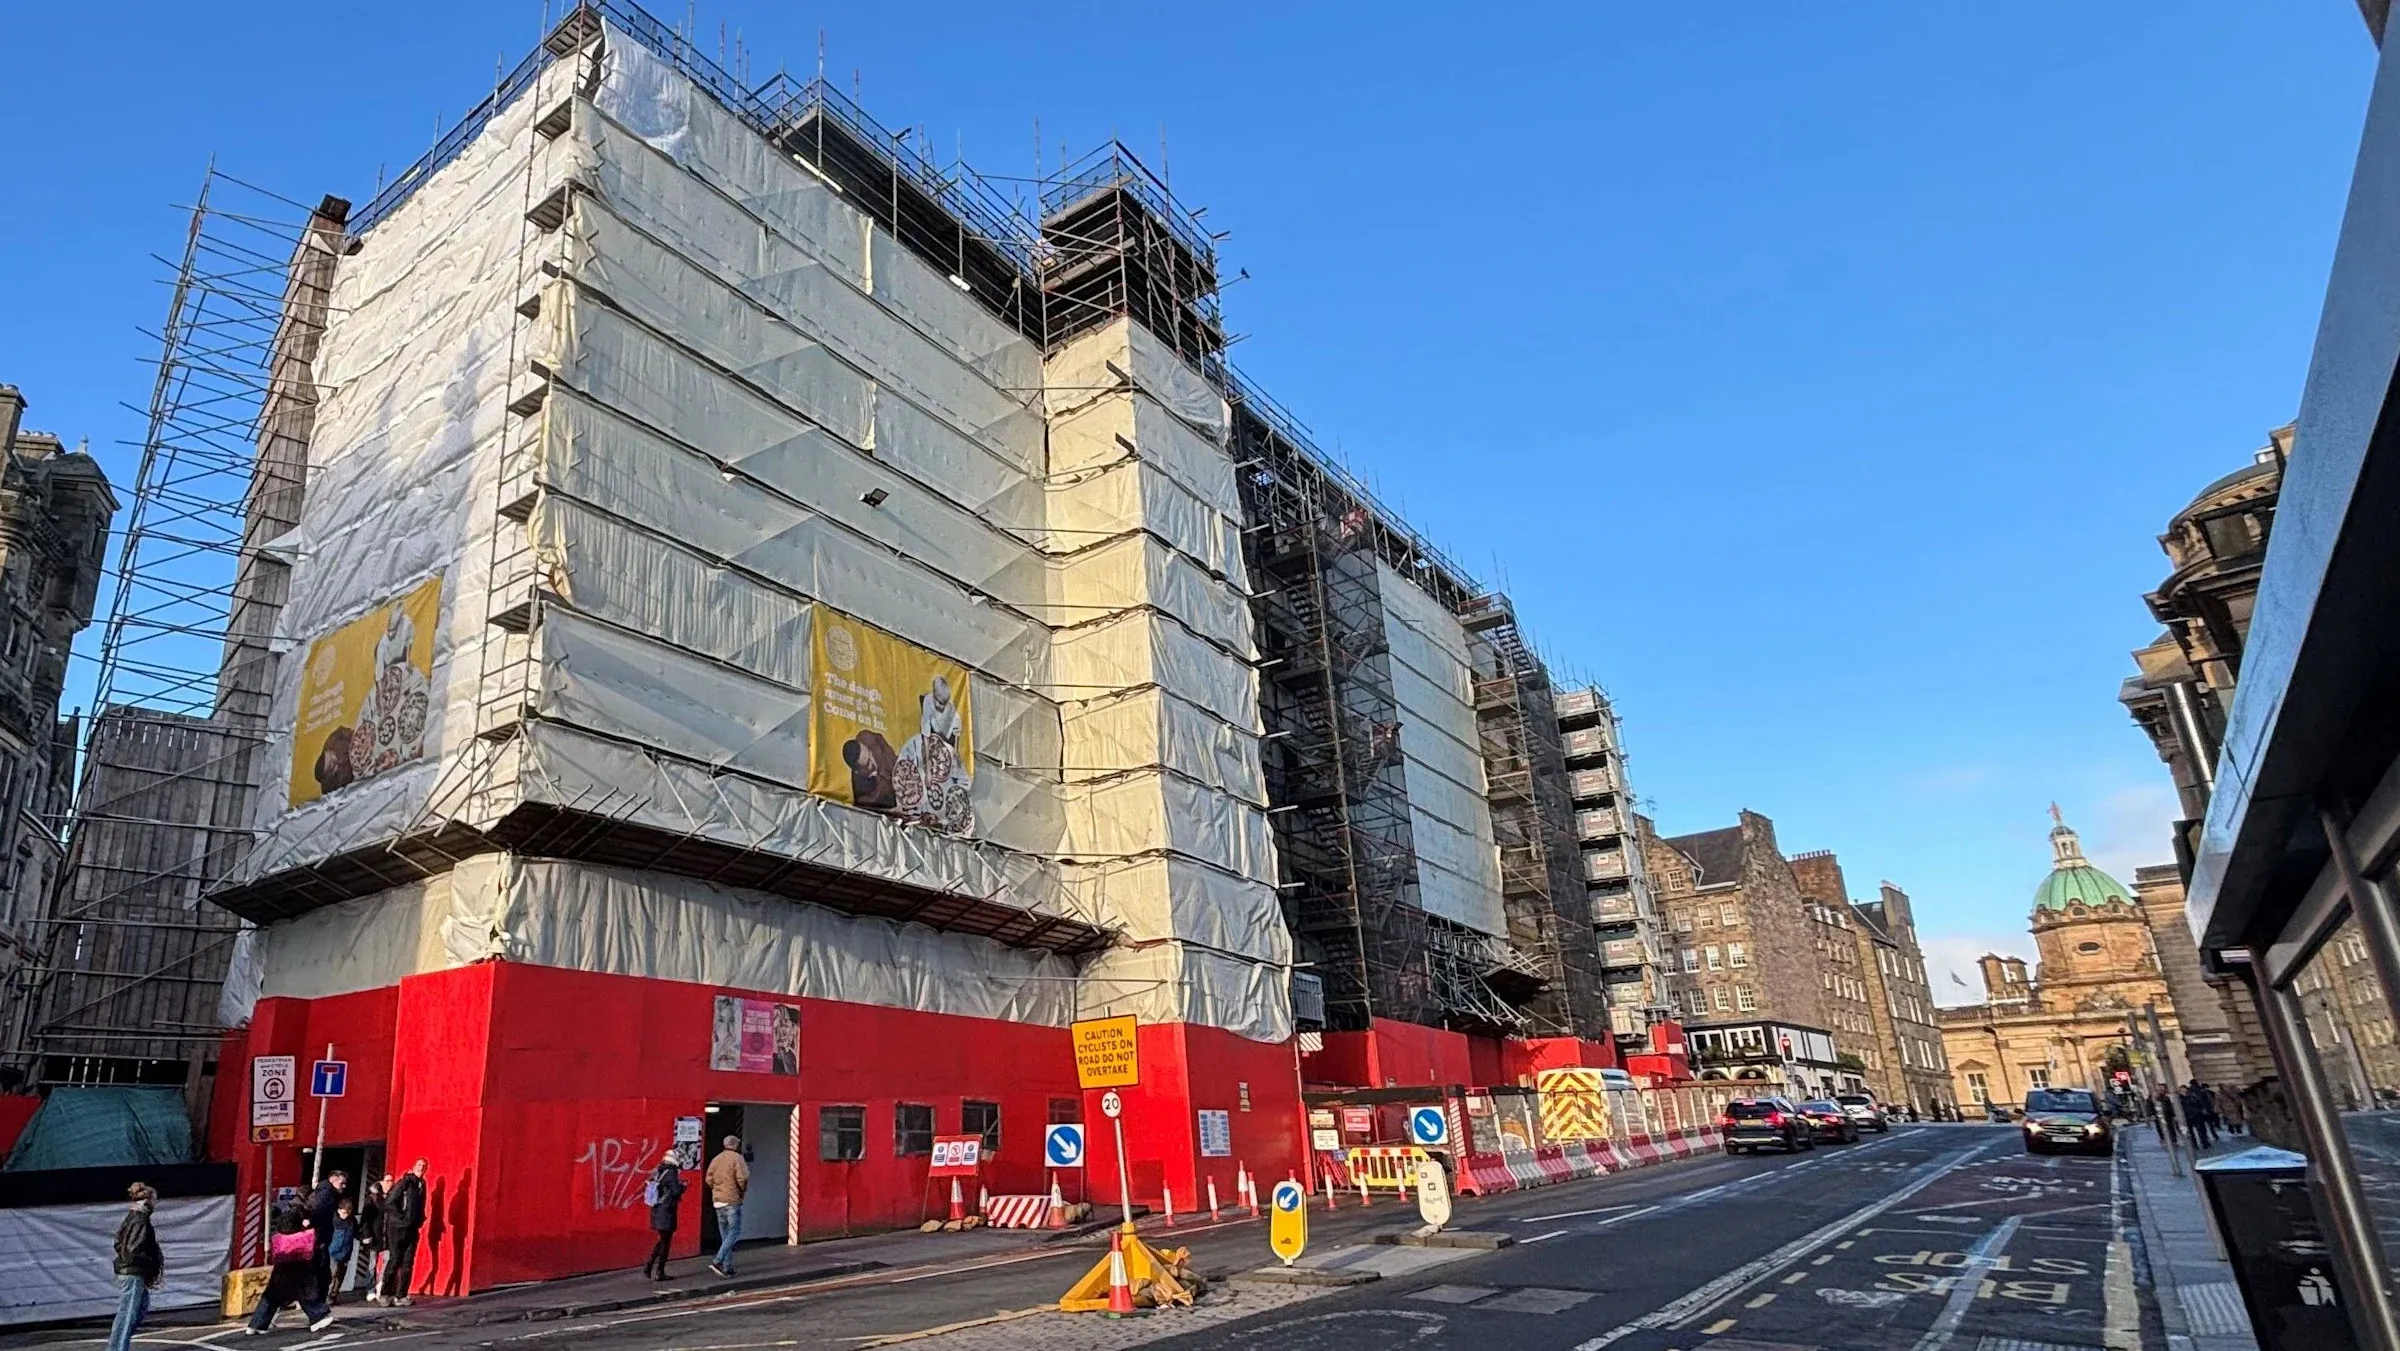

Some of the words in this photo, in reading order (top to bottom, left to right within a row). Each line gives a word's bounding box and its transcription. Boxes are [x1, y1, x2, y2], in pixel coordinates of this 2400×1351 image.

[825, 672, 847, 688] The
[823, 701, 857, 721] Come
[858, 713, 872, 727] on
[1085, 1028, 1123, 1040] CAUTION
[1078, 1041, 1117, 1054] CYCLISTS
[1120, 1039, 1133, 1049] ON
[1078, 1054, 1100, 1065] ROAD
[1102, 1053, 1114, 1063] DO
[1116, 1051, 1134, 1062] NOT
[262, 1069, 287, 1077] ZONE
[1087, 1064, 1128, 1077] OVERTAKE
[1104, 1098, 1119, 1110] 20
[1872, 1250, 2091, 1276] STOP
[1873, 1272, 2070, 1305] BUS
